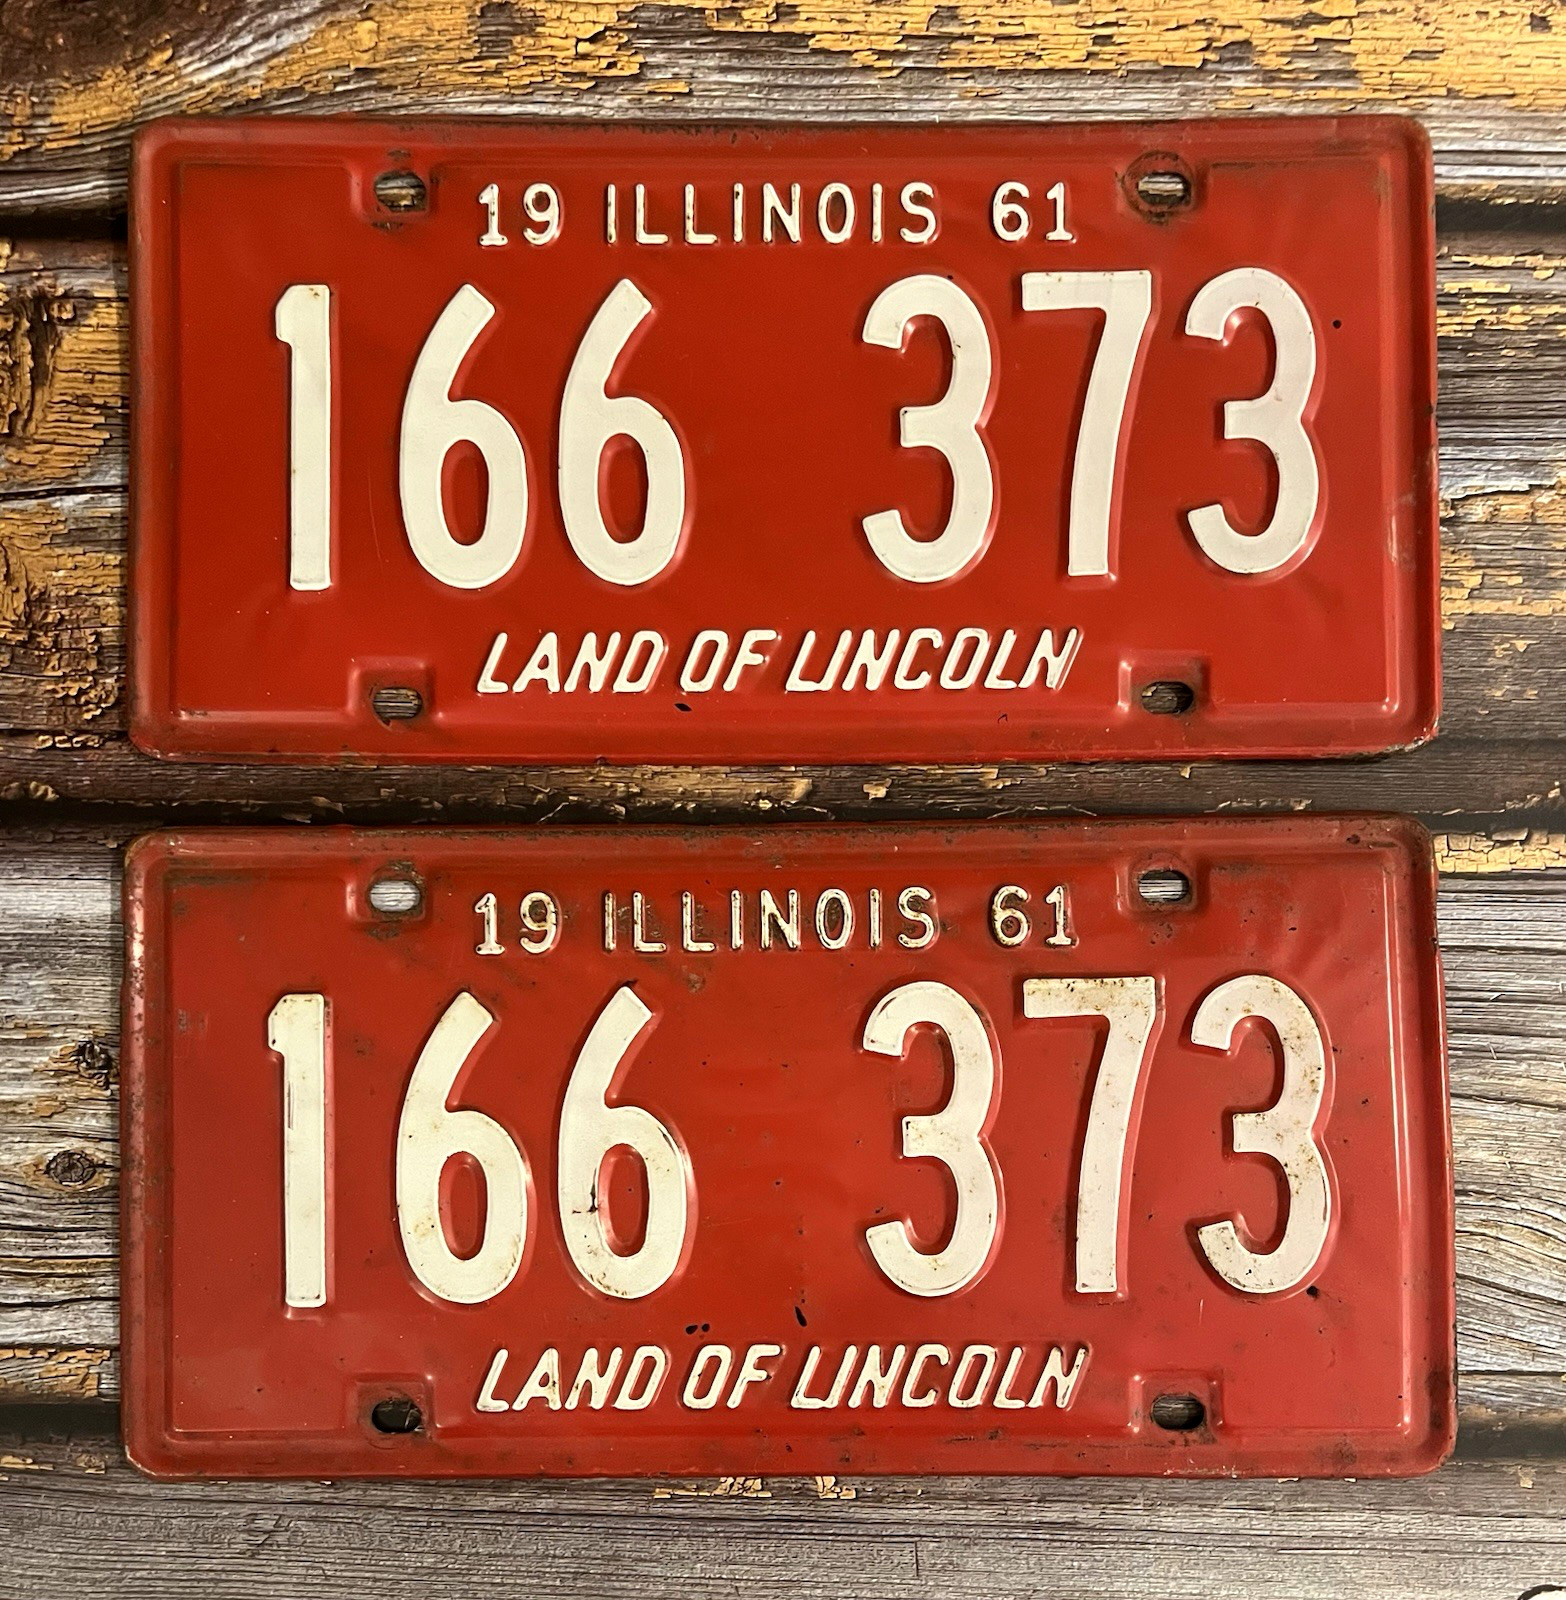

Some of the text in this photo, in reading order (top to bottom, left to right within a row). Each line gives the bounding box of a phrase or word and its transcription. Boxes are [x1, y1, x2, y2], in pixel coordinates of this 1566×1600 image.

[479, 182, 1075, 246] 19 ILLINOIS 61
[275, 267, 1321, 590] 166 373
[477, 628, 1083, 694] LAND OF LINCOLN
[474, 885, 1076, 955] 19 ILLINOIS 61
[268, 974, 1334, 1308] 166 373
[477, 1344, 1086, 1412] LAND OF LINCOLN
